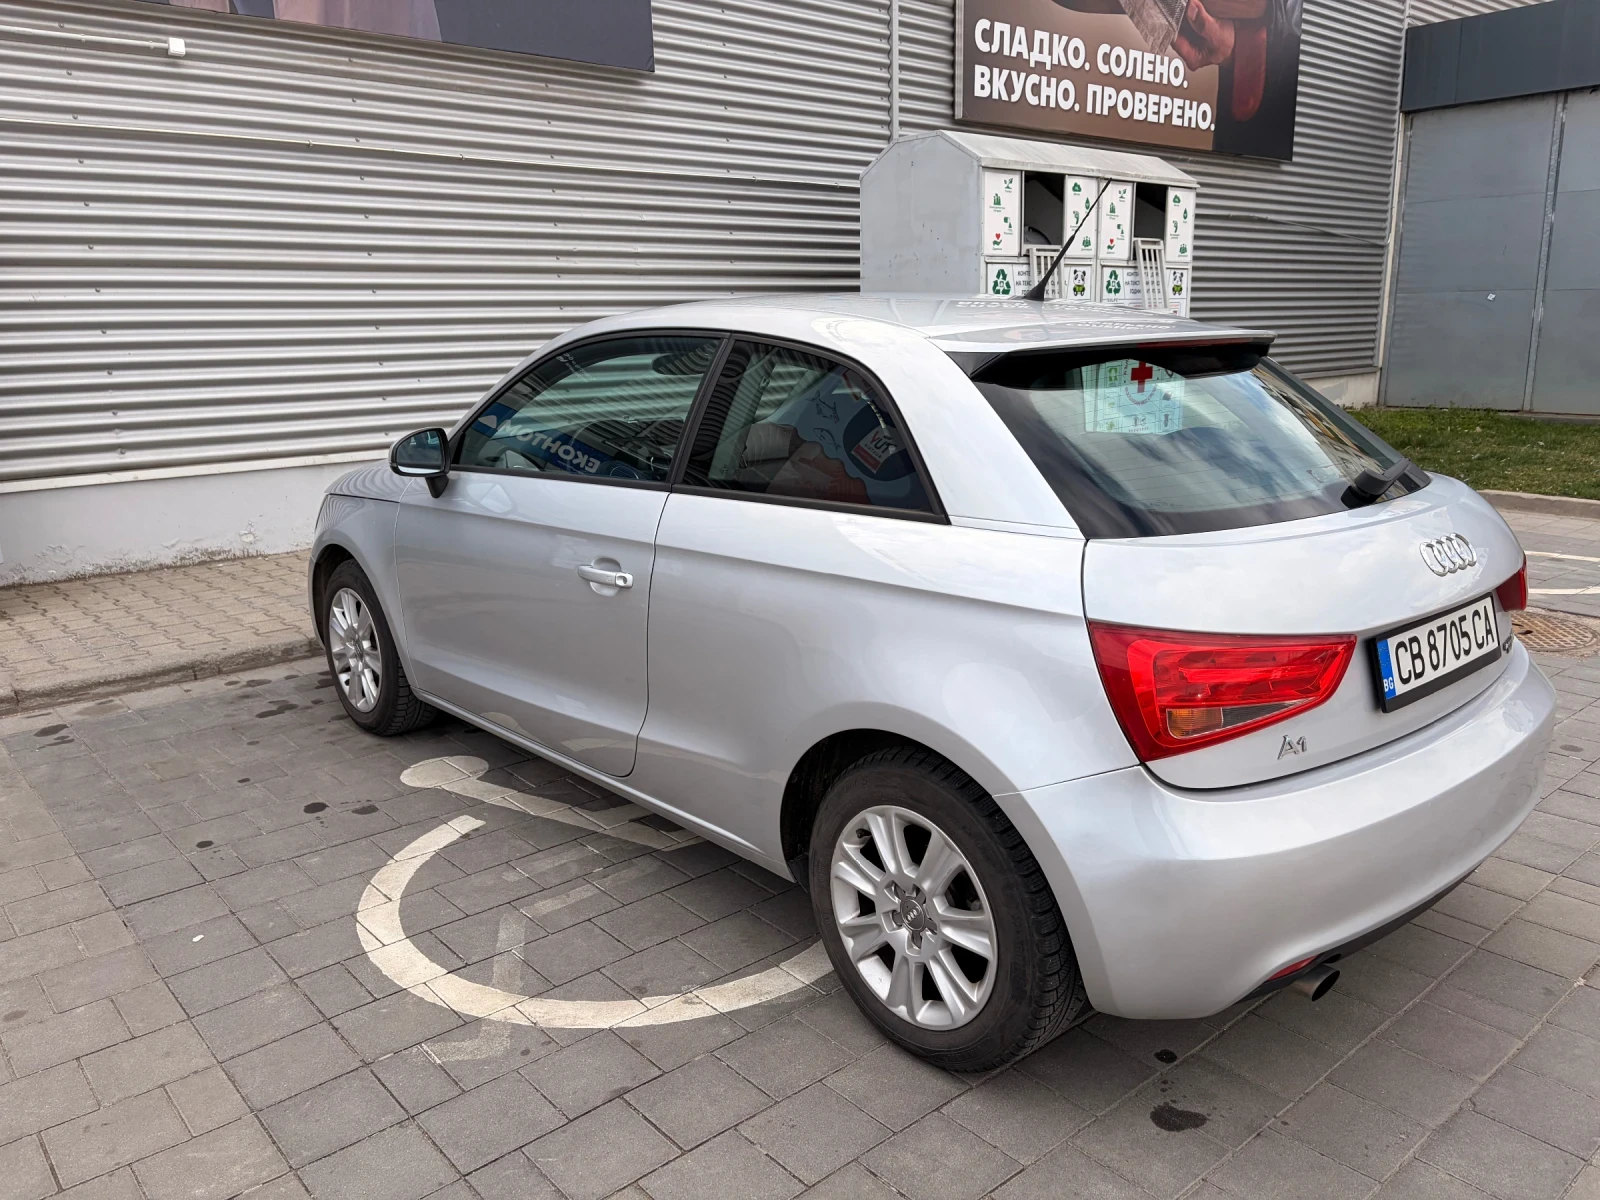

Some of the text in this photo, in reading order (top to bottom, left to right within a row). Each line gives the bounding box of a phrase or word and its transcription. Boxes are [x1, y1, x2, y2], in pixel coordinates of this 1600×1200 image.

[974, 18, 1188, 89] СЛАДКО. СОЛЕНО.
[973, 64, 1215, 131] ВКУСНО. ПРОВЕРЕНО.
[1394, 635, 1425, 685] CB
[1426, 614, 1472, 672] 8705
[1471, 605, 1495, 650] CA
[1382, 676, 1394, 693] BG
[1277, 734, 1308, 760] A1
